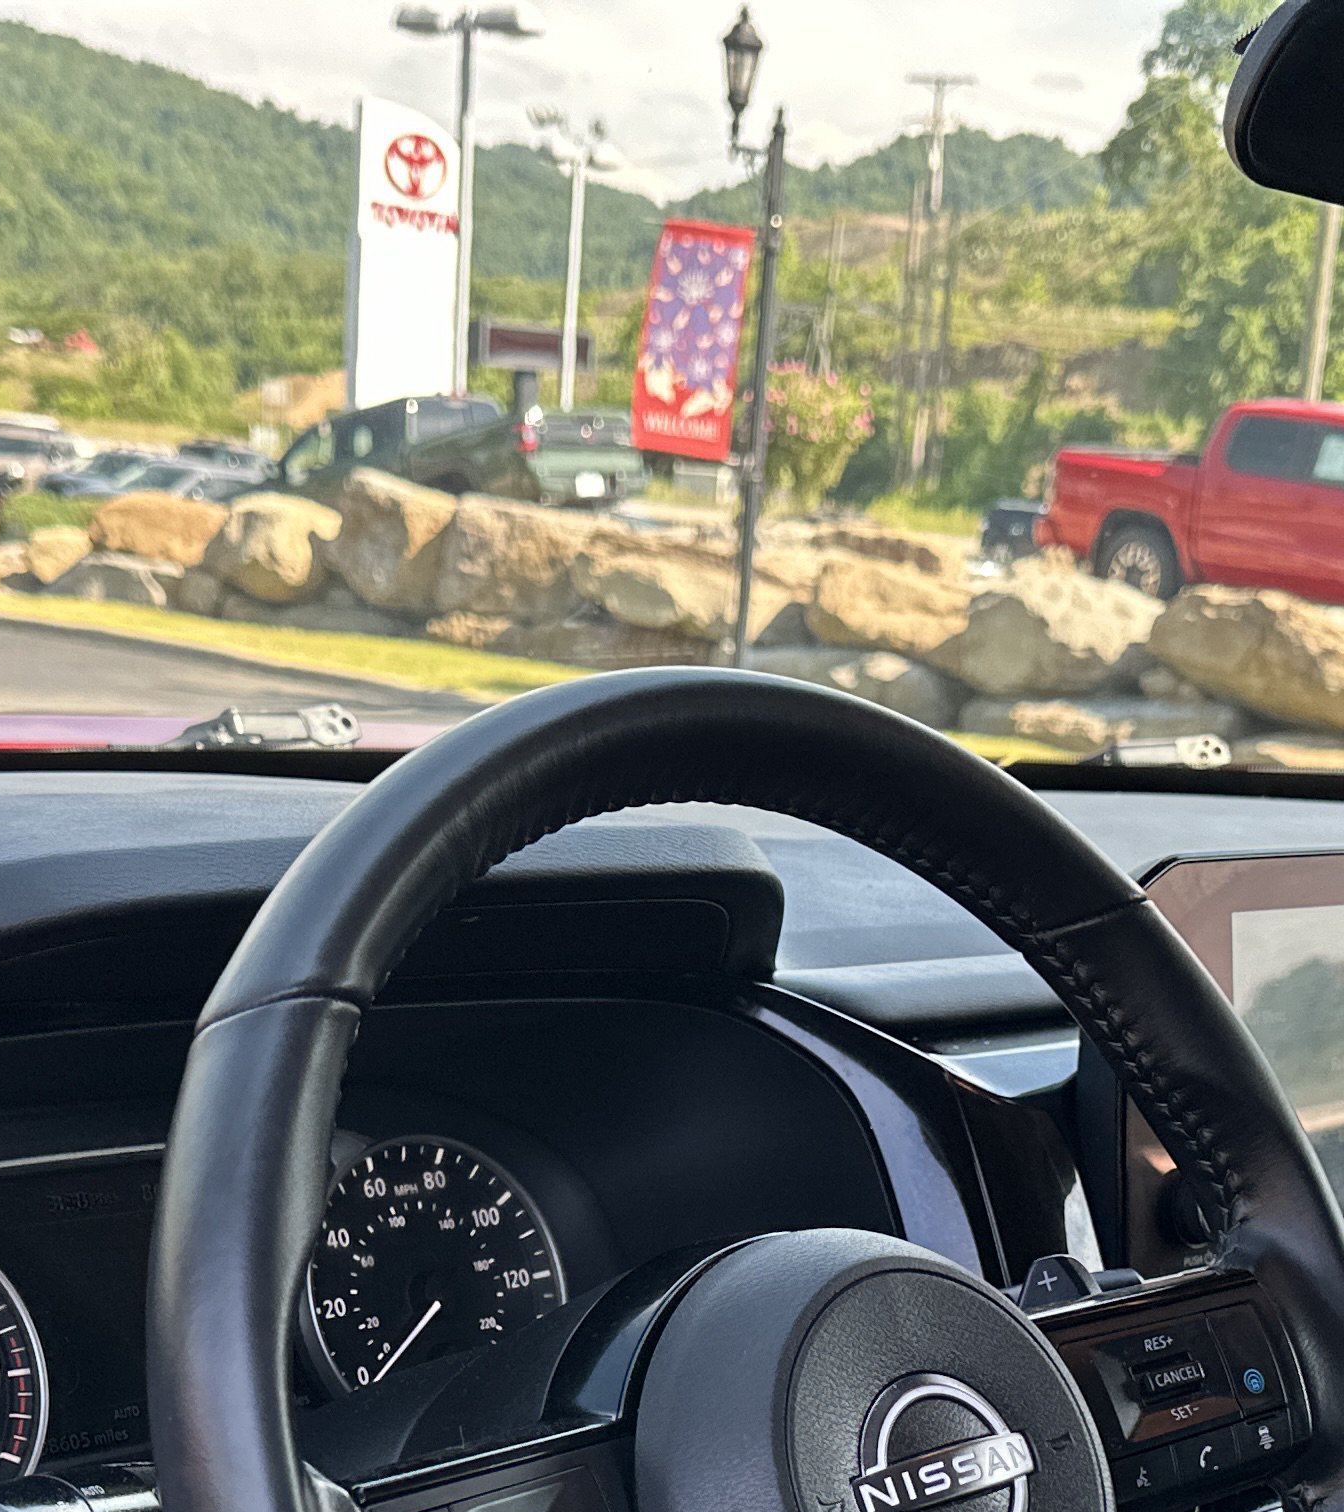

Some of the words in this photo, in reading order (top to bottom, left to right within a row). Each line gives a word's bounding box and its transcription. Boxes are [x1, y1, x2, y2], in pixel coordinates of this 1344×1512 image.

[363, 1178, 386, 1198] 60
[423, 1171, 446, 1190] 80
[472, 1207, 500, 1228] 100
[327, 1228, 350, 1248] 40
[503, 1268, 530, 1289] 120
[323, 1297, 347, 1319] 20
[1143, 1335, 1174, 1352] RES+
[357, 1366, 370, 1386] 0
[1154, 1365, 1201, 1388] CANCEL
